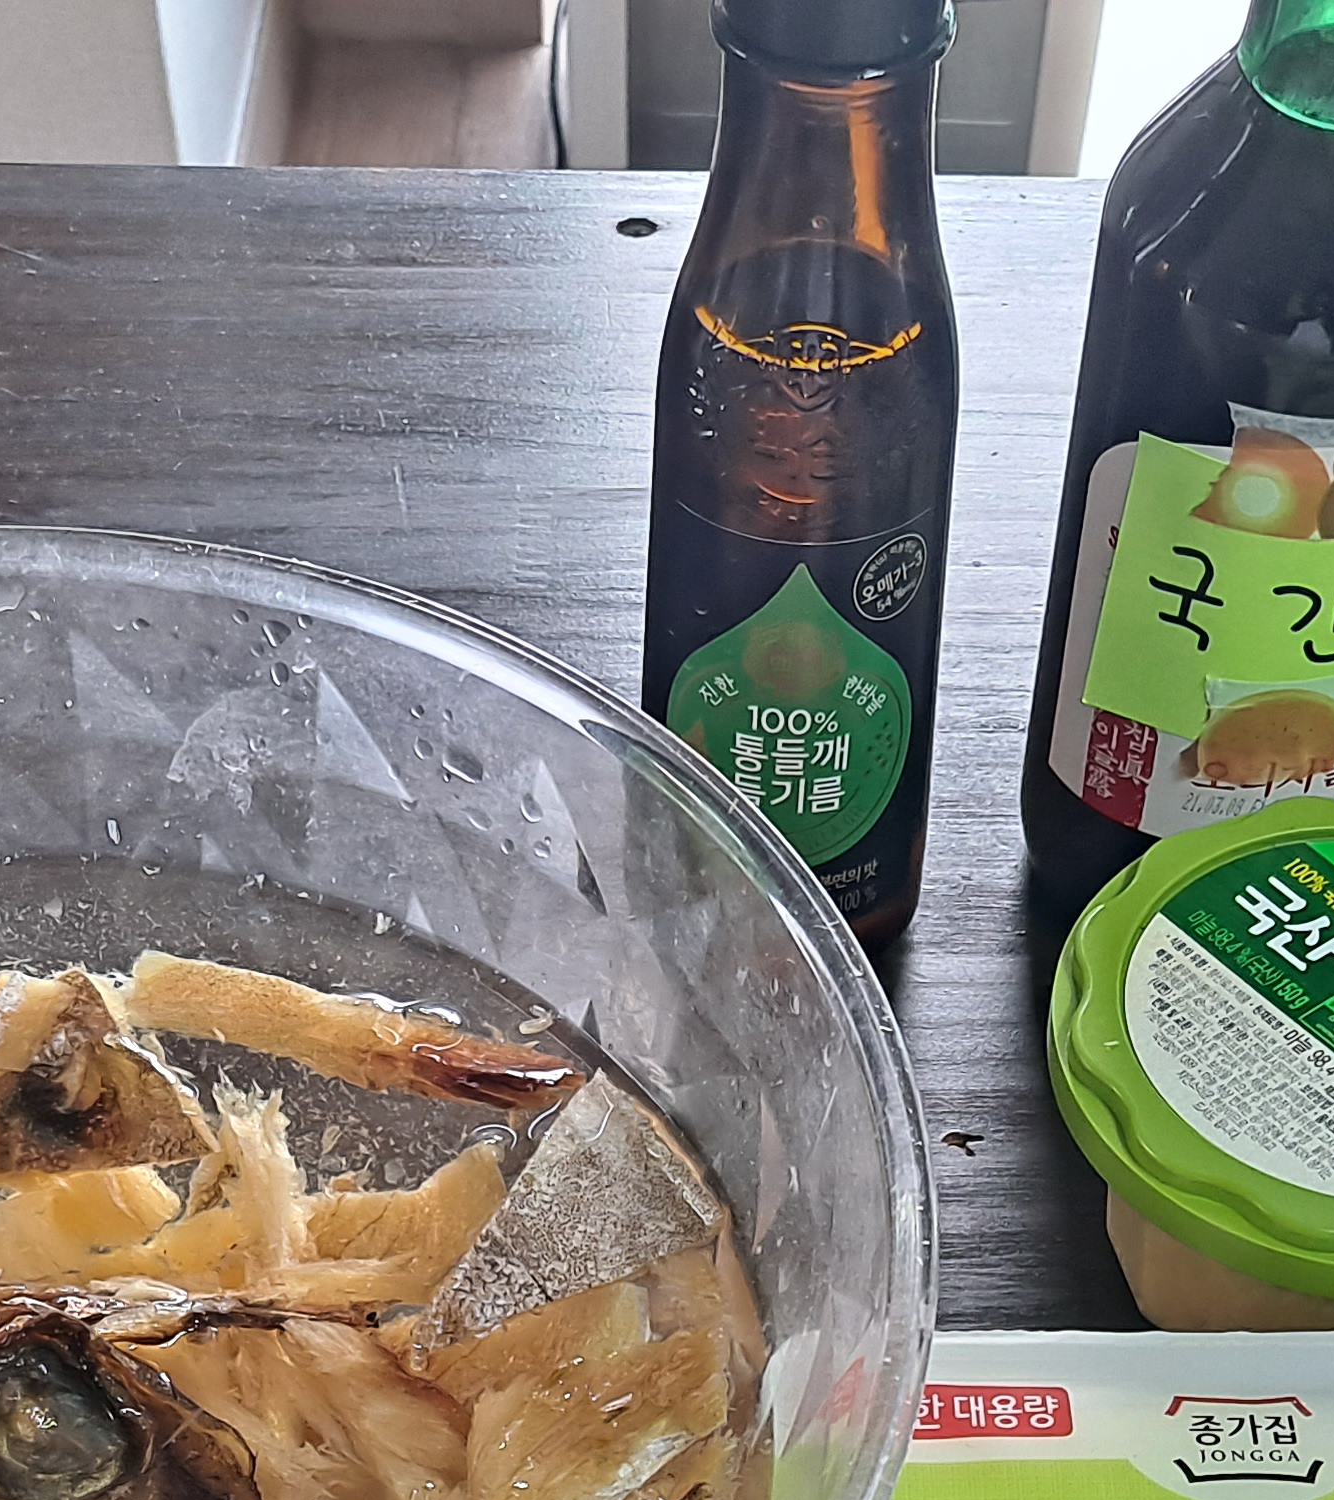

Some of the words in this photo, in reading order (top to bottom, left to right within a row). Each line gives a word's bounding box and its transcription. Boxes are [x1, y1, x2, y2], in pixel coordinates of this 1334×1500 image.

[861, 549, 923, 605] 오메가-3
[698, 673, 739, 706] 진한
[842, 675, 887, 717] 한방울
[747, 704, 839, 736] 100%
[730, 732, 850, 776] 통들깨
[1283, 857, 1329, 893] 100%
[1188, 910, 1218, 937] 마늘
[1208, 927, 1243, 953] 98.4
[1283, 1028, 1313, 1056] 마늘
[953, 1394, 1060, 1431] 대용량
[1188, 1413, 1301, 1447] 종가집
[1198, 1448, 1302, 1465] JONGGA
